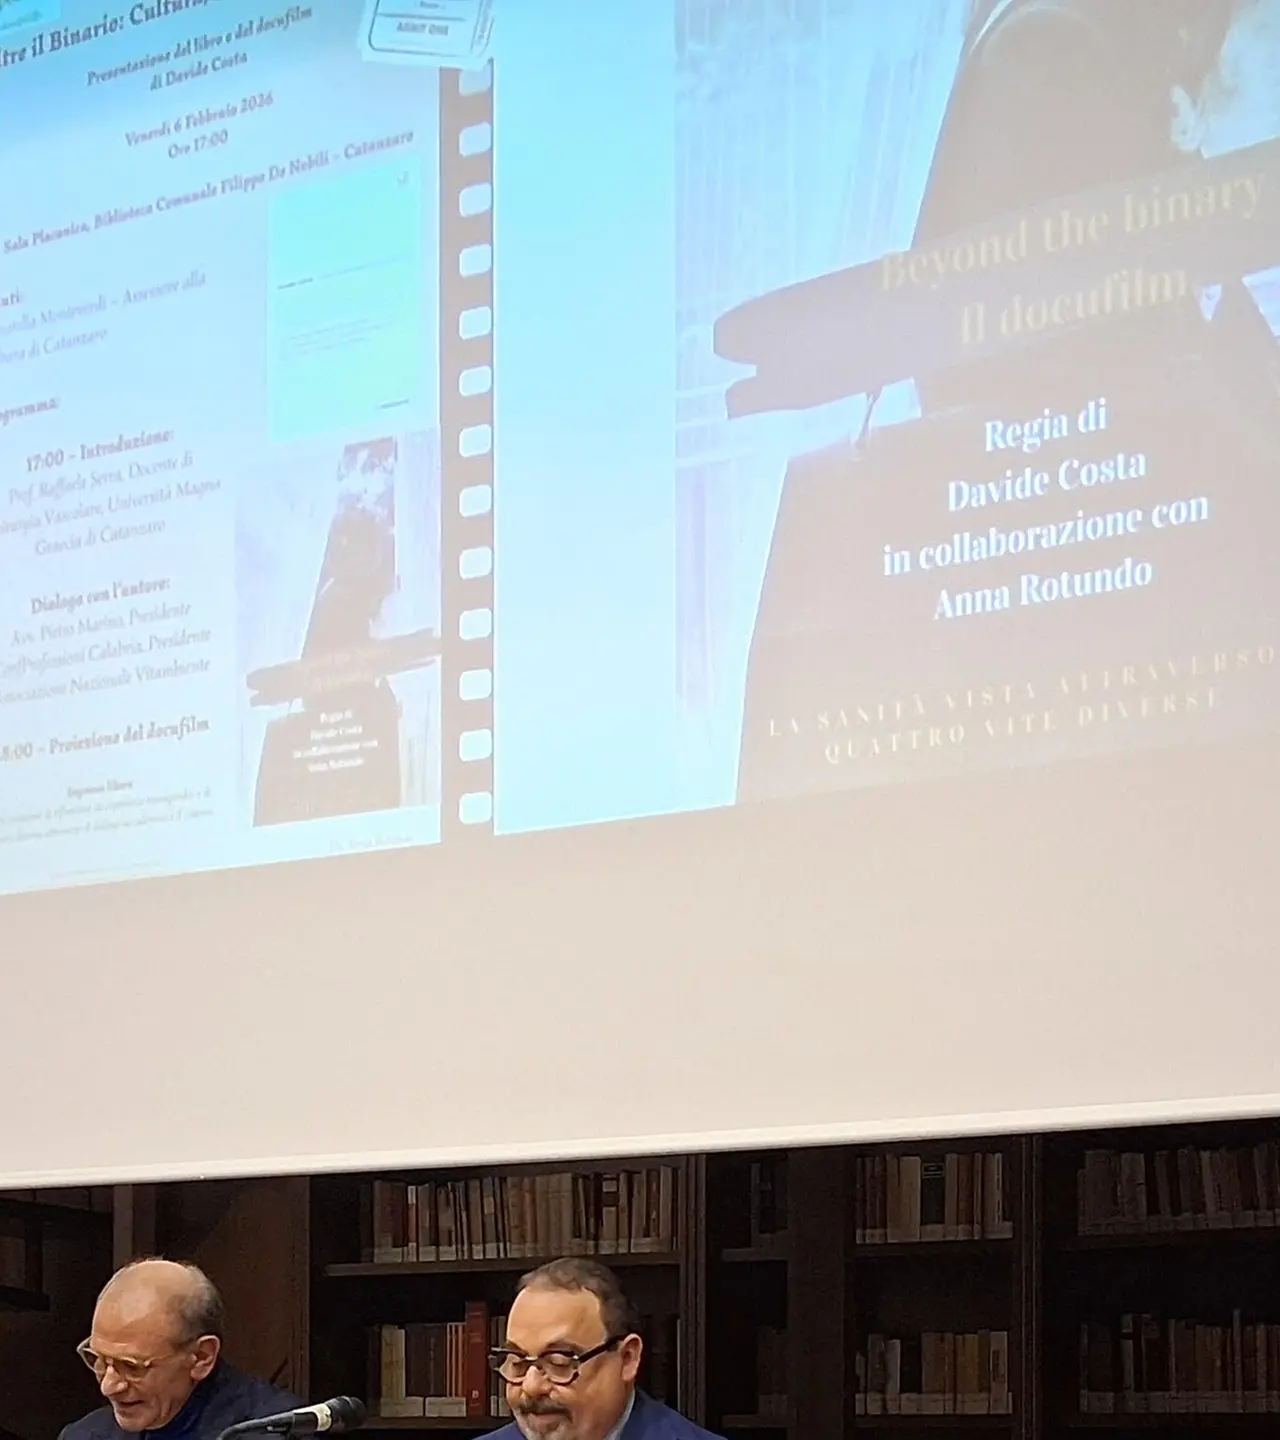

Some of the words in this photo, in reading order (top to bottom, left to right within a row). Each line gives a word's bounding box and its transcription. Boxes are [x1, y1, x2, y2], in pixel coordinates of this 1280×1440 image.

[32, 37, 44, 59] il
[49, 14, 124, 53] Binario:
[86, 49, 171, 87] Presentazione
[173, 40, 192, 61] del
[235, 20, 254, 40] del
[150, 73, 163, 91] di
[165, 61, 209, 86] Davide
[210, 51, 248, 73] Costa
[173, 116, 183, 133] 6
[185, 102, 238, 130] Febbraio
[240, 88, 274, 113] 2026
[168, 141, 191, 159] Ore
[193, 127, 229, 153] 17:00
[3, 234, 30, 254] Sala
[94, 202, 154, 231] Biblioteca
[155, 181, 219, 213] Comunale
[220, 171, 266, 197] Filippo
[268, 163, 288, 182] De
[289, 148, 331, 177] Nobili
[343, 129, 414, 161] Catanzaro
[879, 217, 1028, 292] Beyond
[1041, 206, 1111, 253] the
[1122, 172, 1268, 234] binary
[959, 298, 988, 345] Il
[998, 266, 1189, 339] docufilm
[25, 447, 65, 473] 17:00
[79, 427, 176, 461] Introduzione:
[984, 407, 1070, 454] Regia
[1076, 395, 1108, 435] di
[947, 464, 1051, 513] Davide
[1057, 451, 1148, 492] Costa
[881, 544, 913, 578] in
[917, 508, 1144, 572] collaborazione
[1150, 494, 1211, 531] con
[30, 591, 84, 617] Dialogo
[86, 587, 111, 605] con
[932, 583, 1011, 622] Anna
[1019, 556, 1154, 607] Rotundo
[768, 716, 801, 739] LA
[943, 679, 1037, 713] VISTA
[1059, 643, 1278, 698] ATTRAVERSO
[48, 731, 121, 757] Proiezione
[122, 721, 145, 745] del
[146, 713, 212, 743] docufilm
[824, 723, 967, 766] QUATTRO
[983, 708, 1060, 741] VITE
